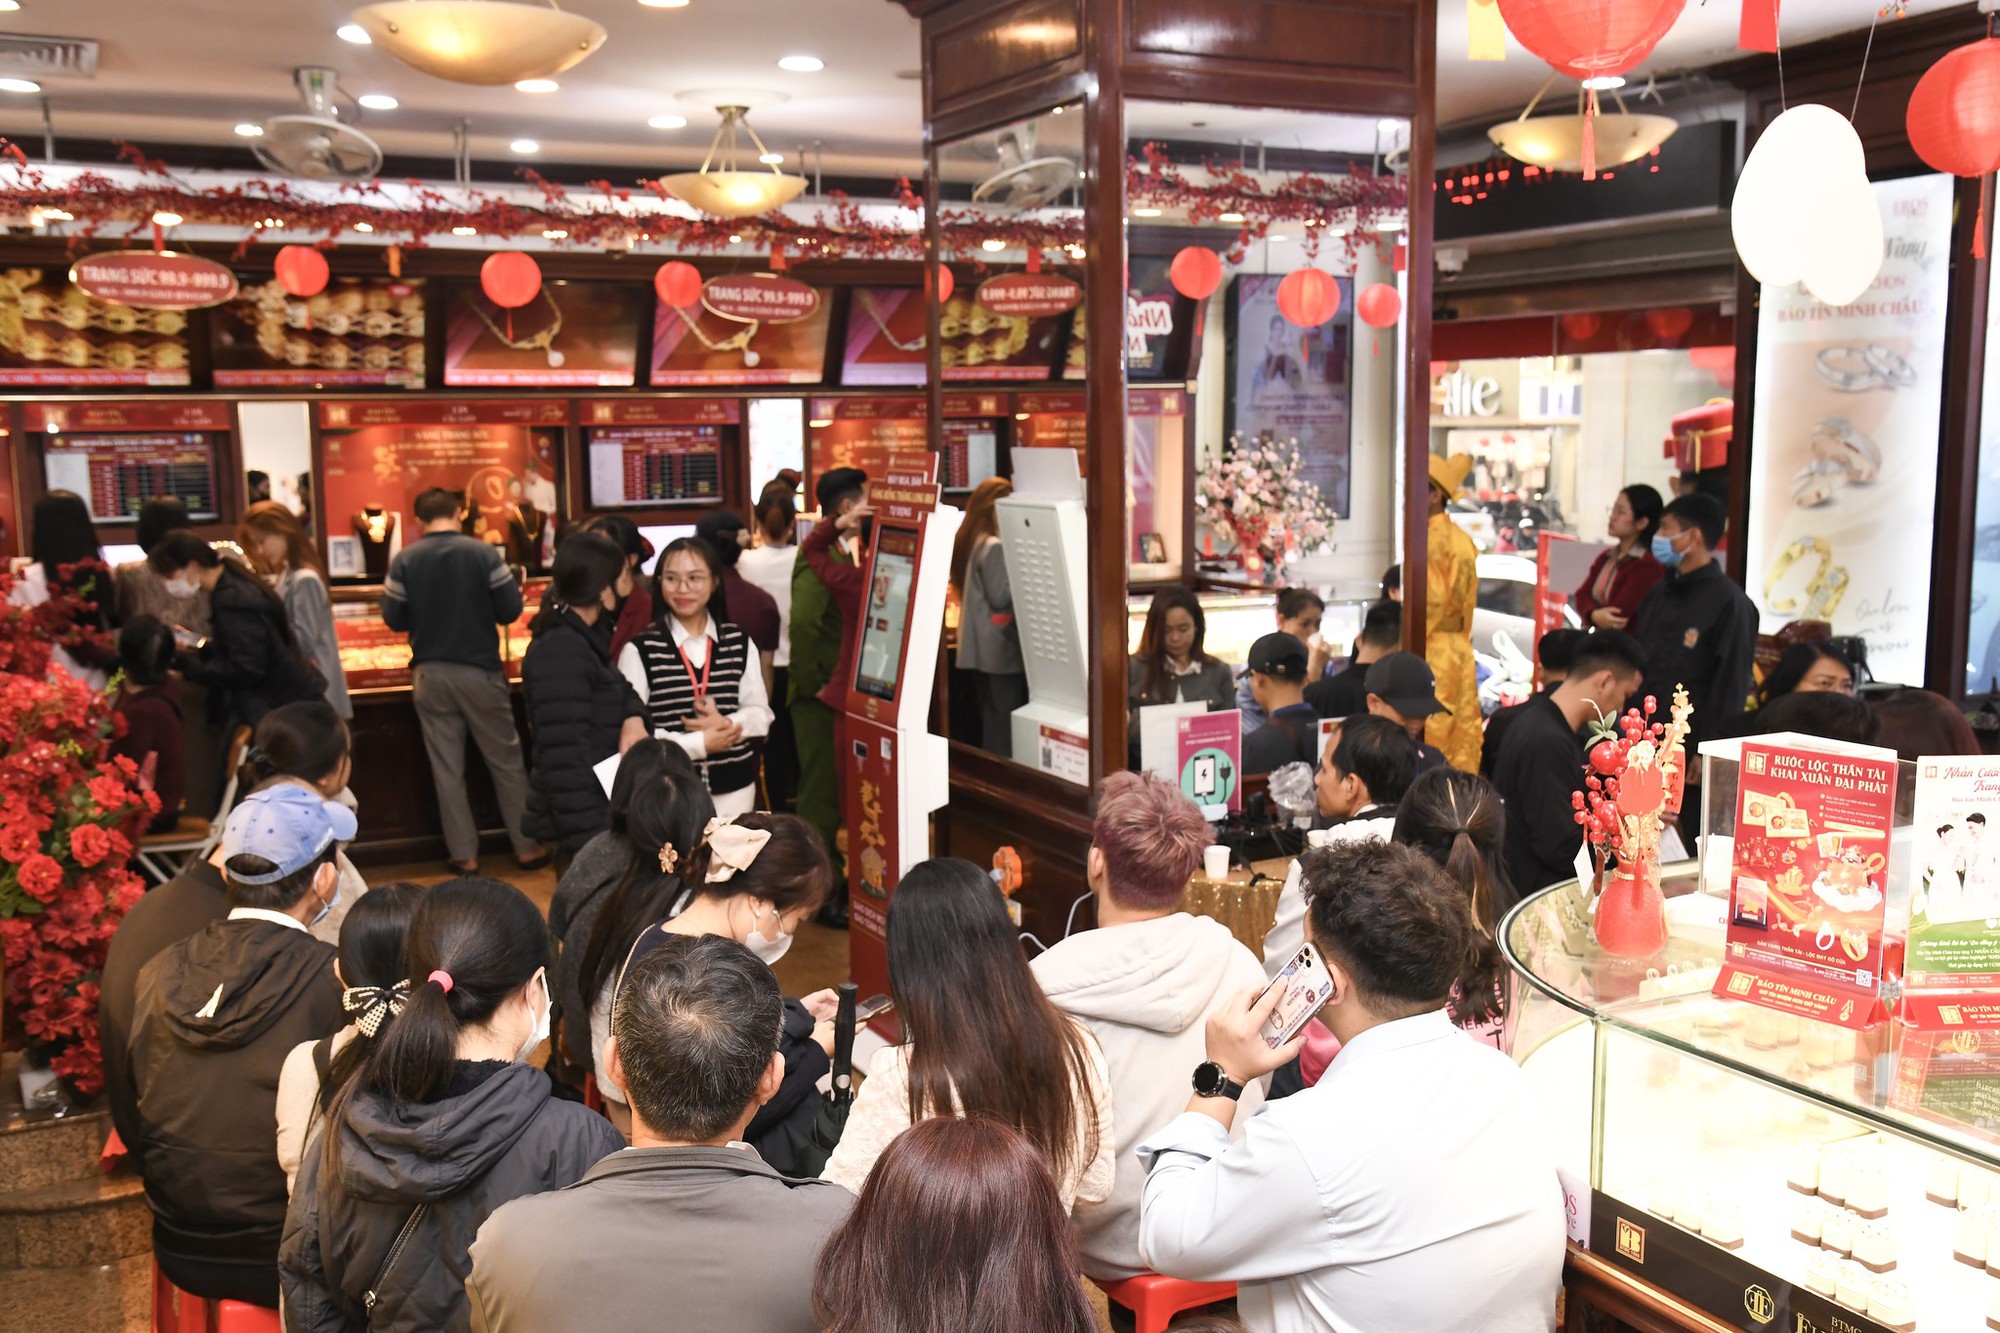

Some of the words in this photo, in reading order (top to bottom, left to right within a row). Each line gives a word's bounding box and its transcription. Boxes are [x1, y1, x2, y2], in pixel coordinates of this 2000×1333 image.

[81, 265, 129, 284] TRANG
[130, 265, 158, 285] SỨC
[709, 285, 741, 302] TRANG
[743, 285, 761, 302] SỨC
[1836, 302, 1875, 318] MINH
[1774, 755, 1804, 769] RƯỚC
[1808, 759, 1829, 773] LỘC
[1833, 763, 1863, 777] THẦN
[1867, 768, 1886, 781] TÀI
[1770, 767, 1797, 780] KHAI
[1800, 770, 1831, 785] XUÂN
[1835, 777, 1855, 790] ĐẠI
[1858, 781, 1888, 794] PHÁT
[1756, 978, 1774, 989] BẢO
[1775, 983, 1789, 993] TÍN
[1789, 986, 1813, 998] MINH
[1813, 992, 1838, 1005] CHÂU
[1962, 1005, 1978, 1013] BẢO
[1979, 1004, 1991, 1012] TÍN
